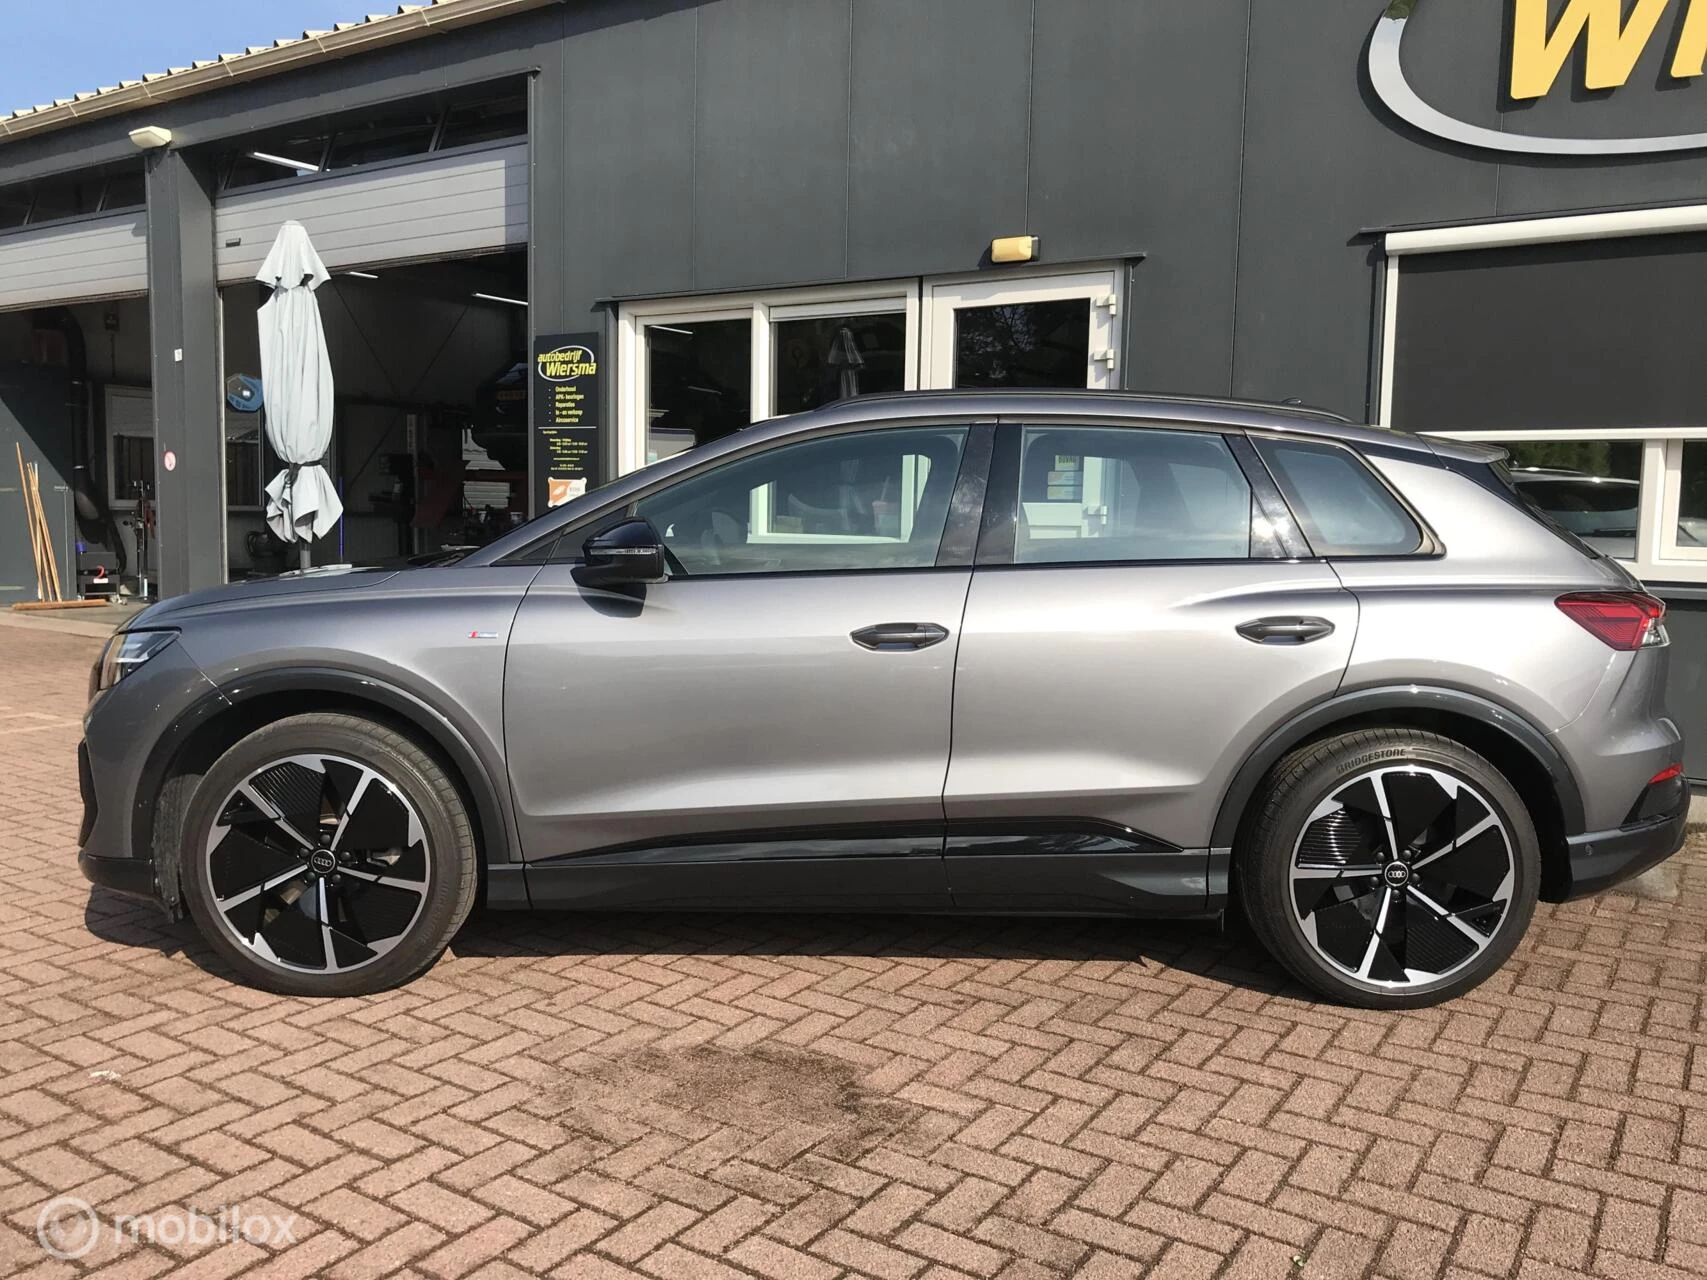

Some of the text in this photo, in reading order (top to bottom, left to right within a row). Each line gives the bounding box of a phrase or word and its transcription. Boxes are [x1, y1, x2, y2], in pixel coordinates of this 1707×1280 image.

[537, 350, 583, 363] autobedrijf
[546, 361, 597, 376] Wiersma
[1336, 748, 1406, 774] BRIDGESTONE
